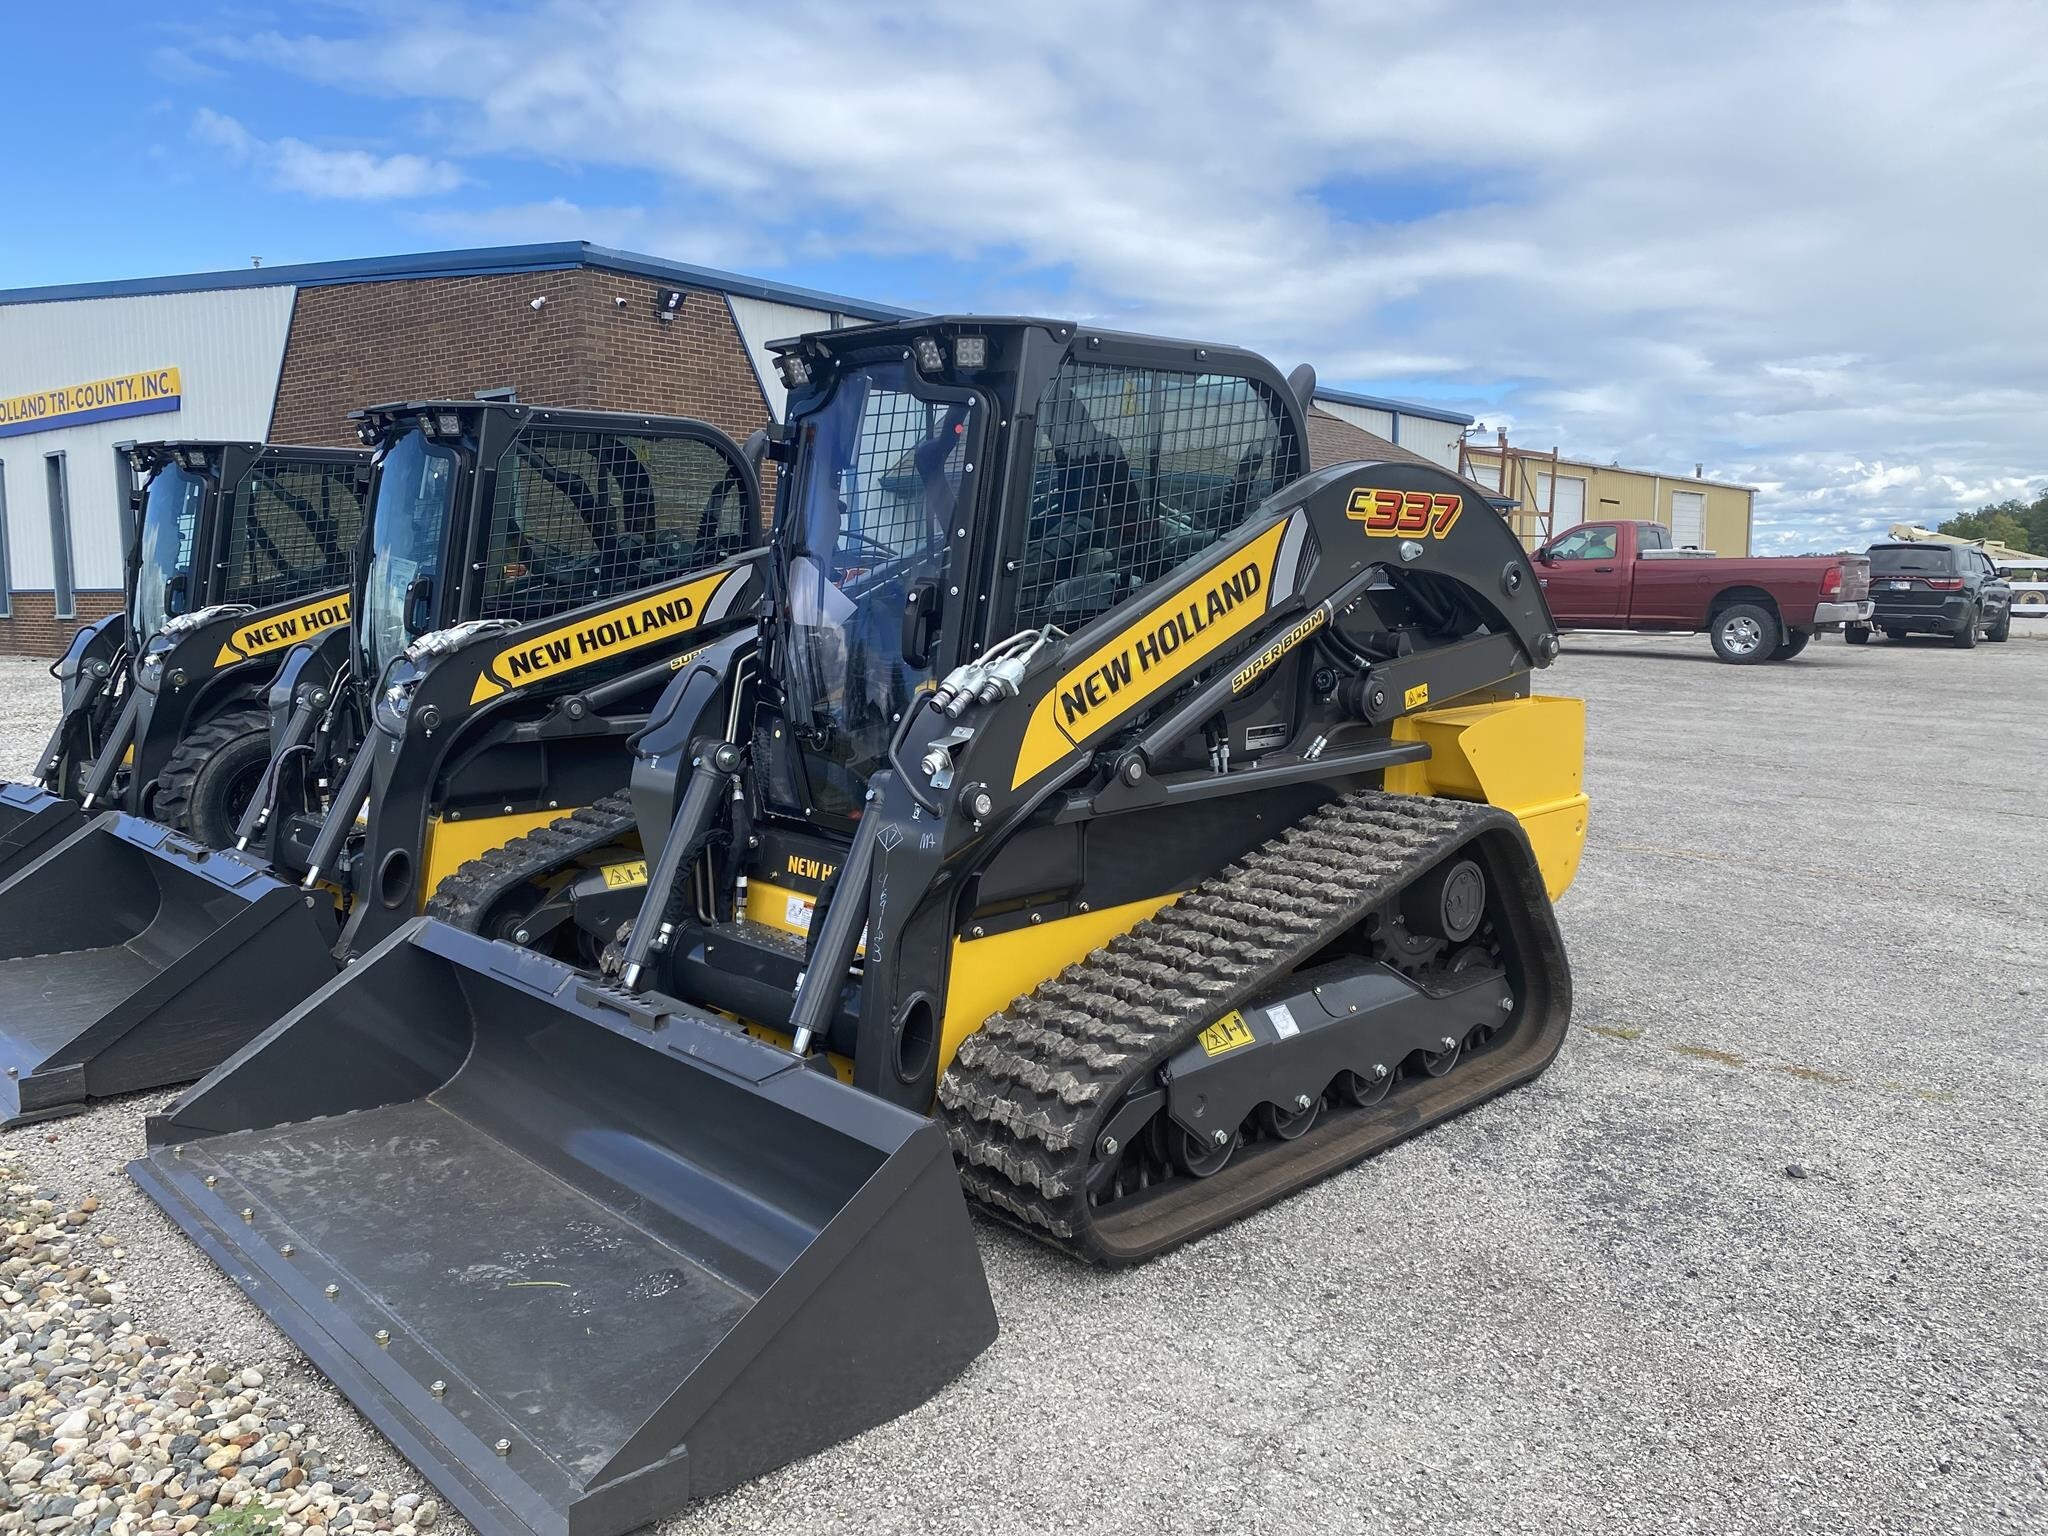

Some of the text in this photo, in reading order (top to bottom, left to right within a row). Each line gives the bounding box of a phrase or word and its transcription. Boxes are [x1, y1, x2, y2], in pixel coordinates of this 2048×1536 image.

[50, 378, 137, 413] TRI-COUNTY,
[142, 372, 174, 397] INC.
[245, 618, 296, 649] NEW
[507, 597, 693, 678] NEW HOLLAND
[1060, 562, 1261, 725] NEW HOLLAND
[1232, 609, 1324, 694] SUPER BOOM
[788, 855, 839, 882] NEW H
